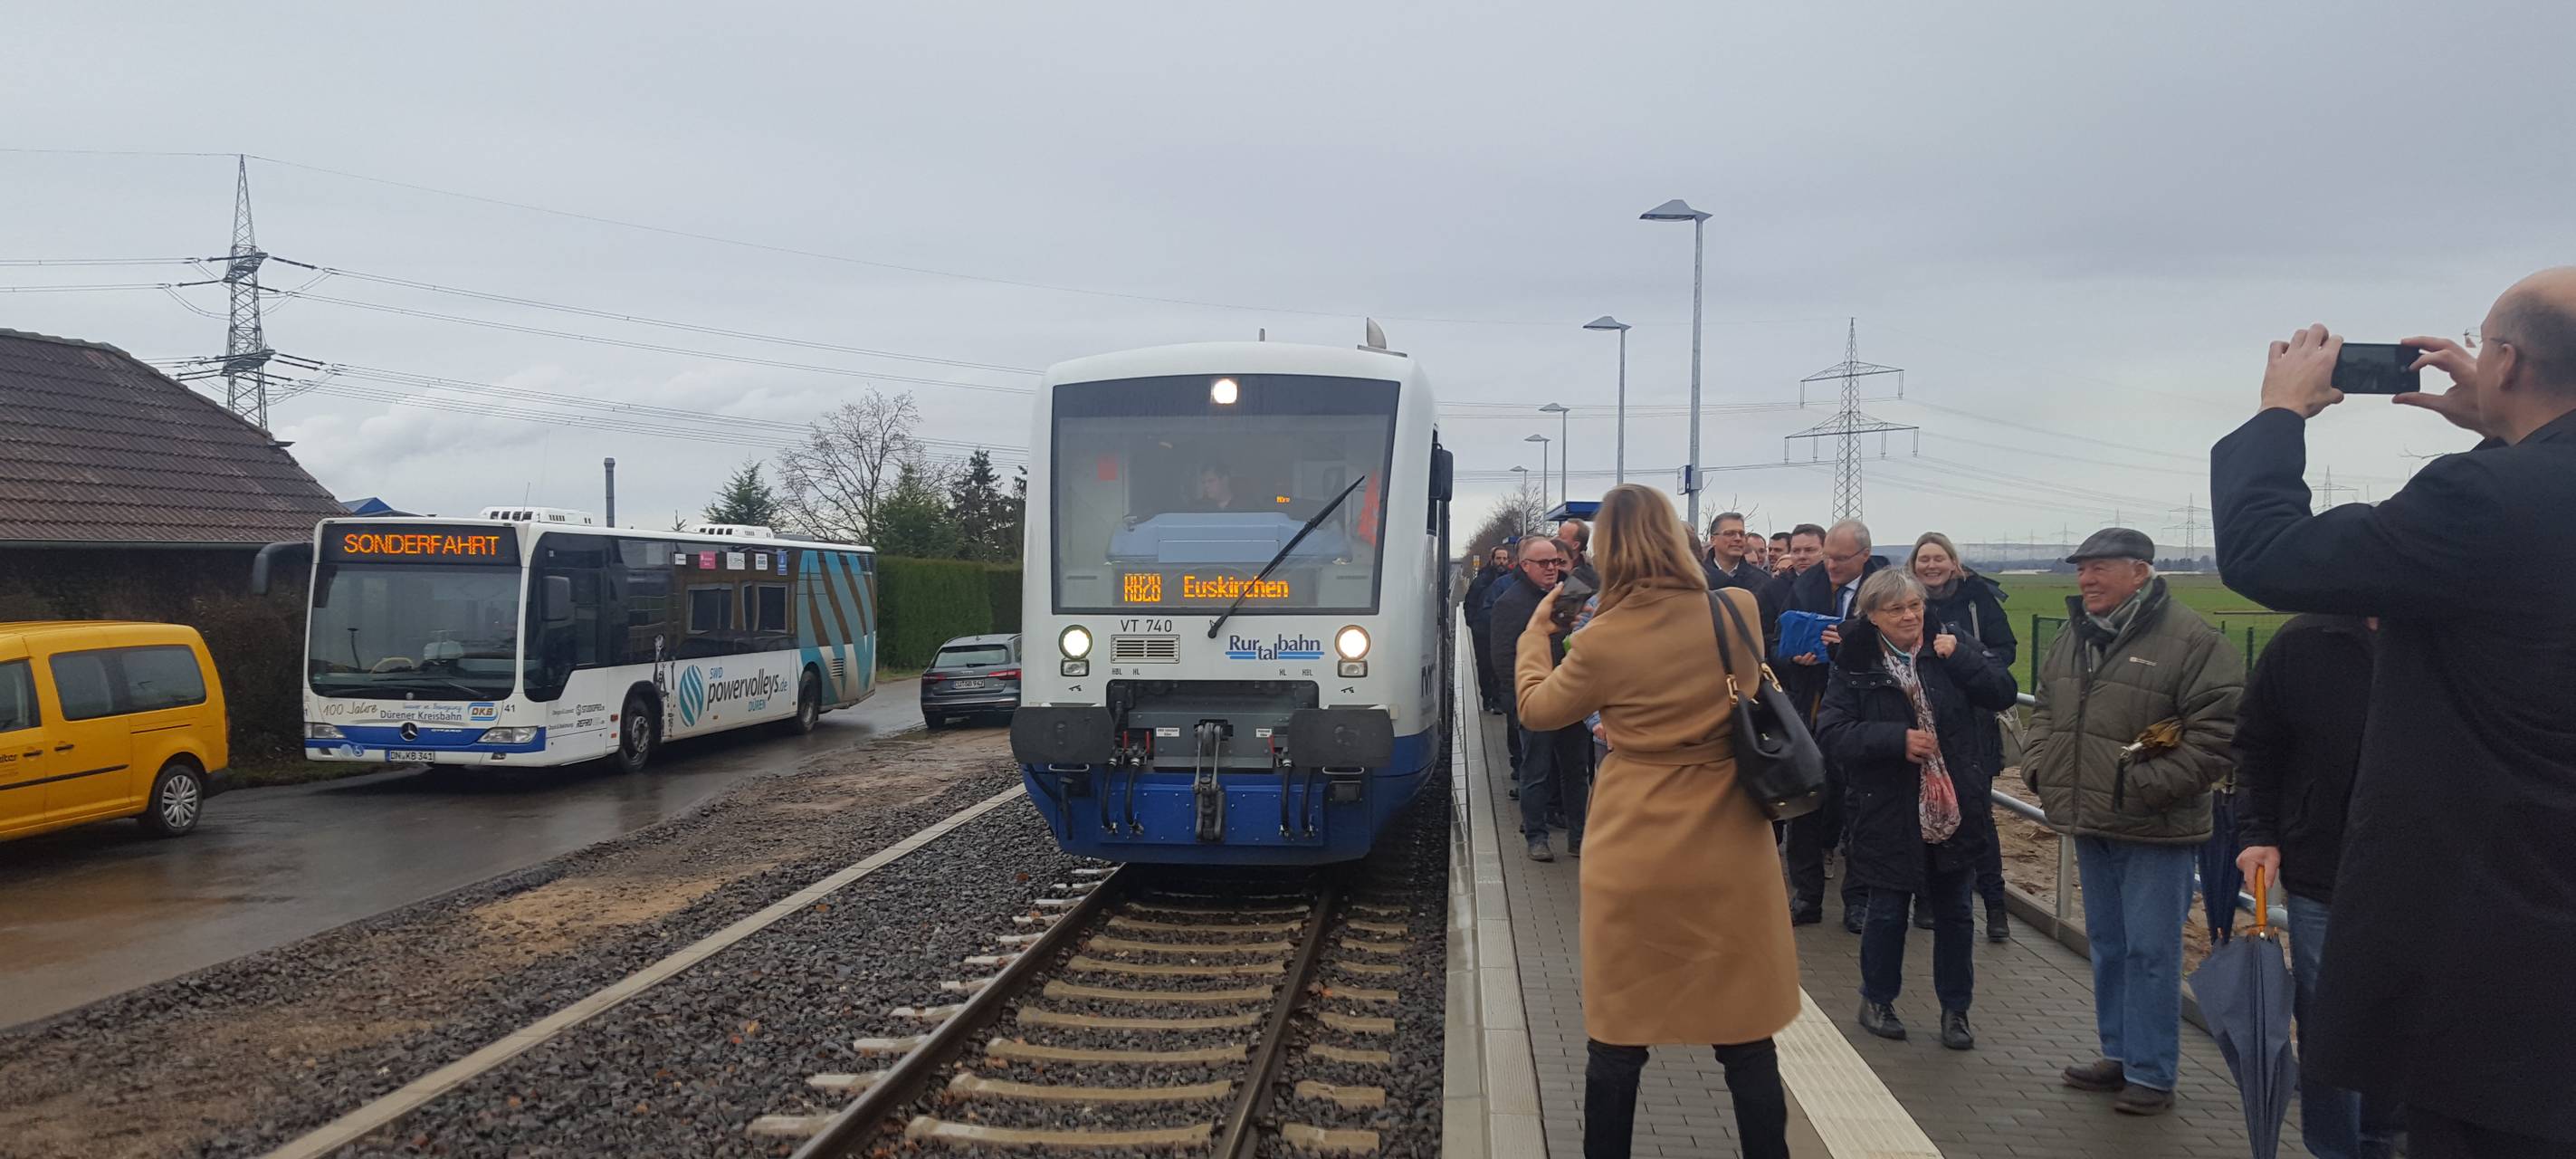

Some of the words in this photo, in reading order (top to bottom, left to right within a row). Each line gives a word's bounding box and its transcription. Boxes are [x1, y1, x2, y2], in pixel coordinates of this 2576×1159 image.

[343, 532, 501, 556] SONDERFAHRT
[1183, 574, 1290, 599] Euskirchen
[1121, 619, 1140, 633] VT
[1146, 619, 1173, 633] 740
[709, 666, 724, 680] SWD
[322, 704, 344, 716] 100
[347, 701, 378, 715] Jahre
[471, 707, 494, 716] DKB
[504, 704, 516, 713] 41
[380, 710, 415, 720] Dürener
[417, 710, 463, 722] Kreisbahn
[390, 752, 401, 760] DN
[406, 752, 416, 761] KB
[418, 752, 433, 761] 341
